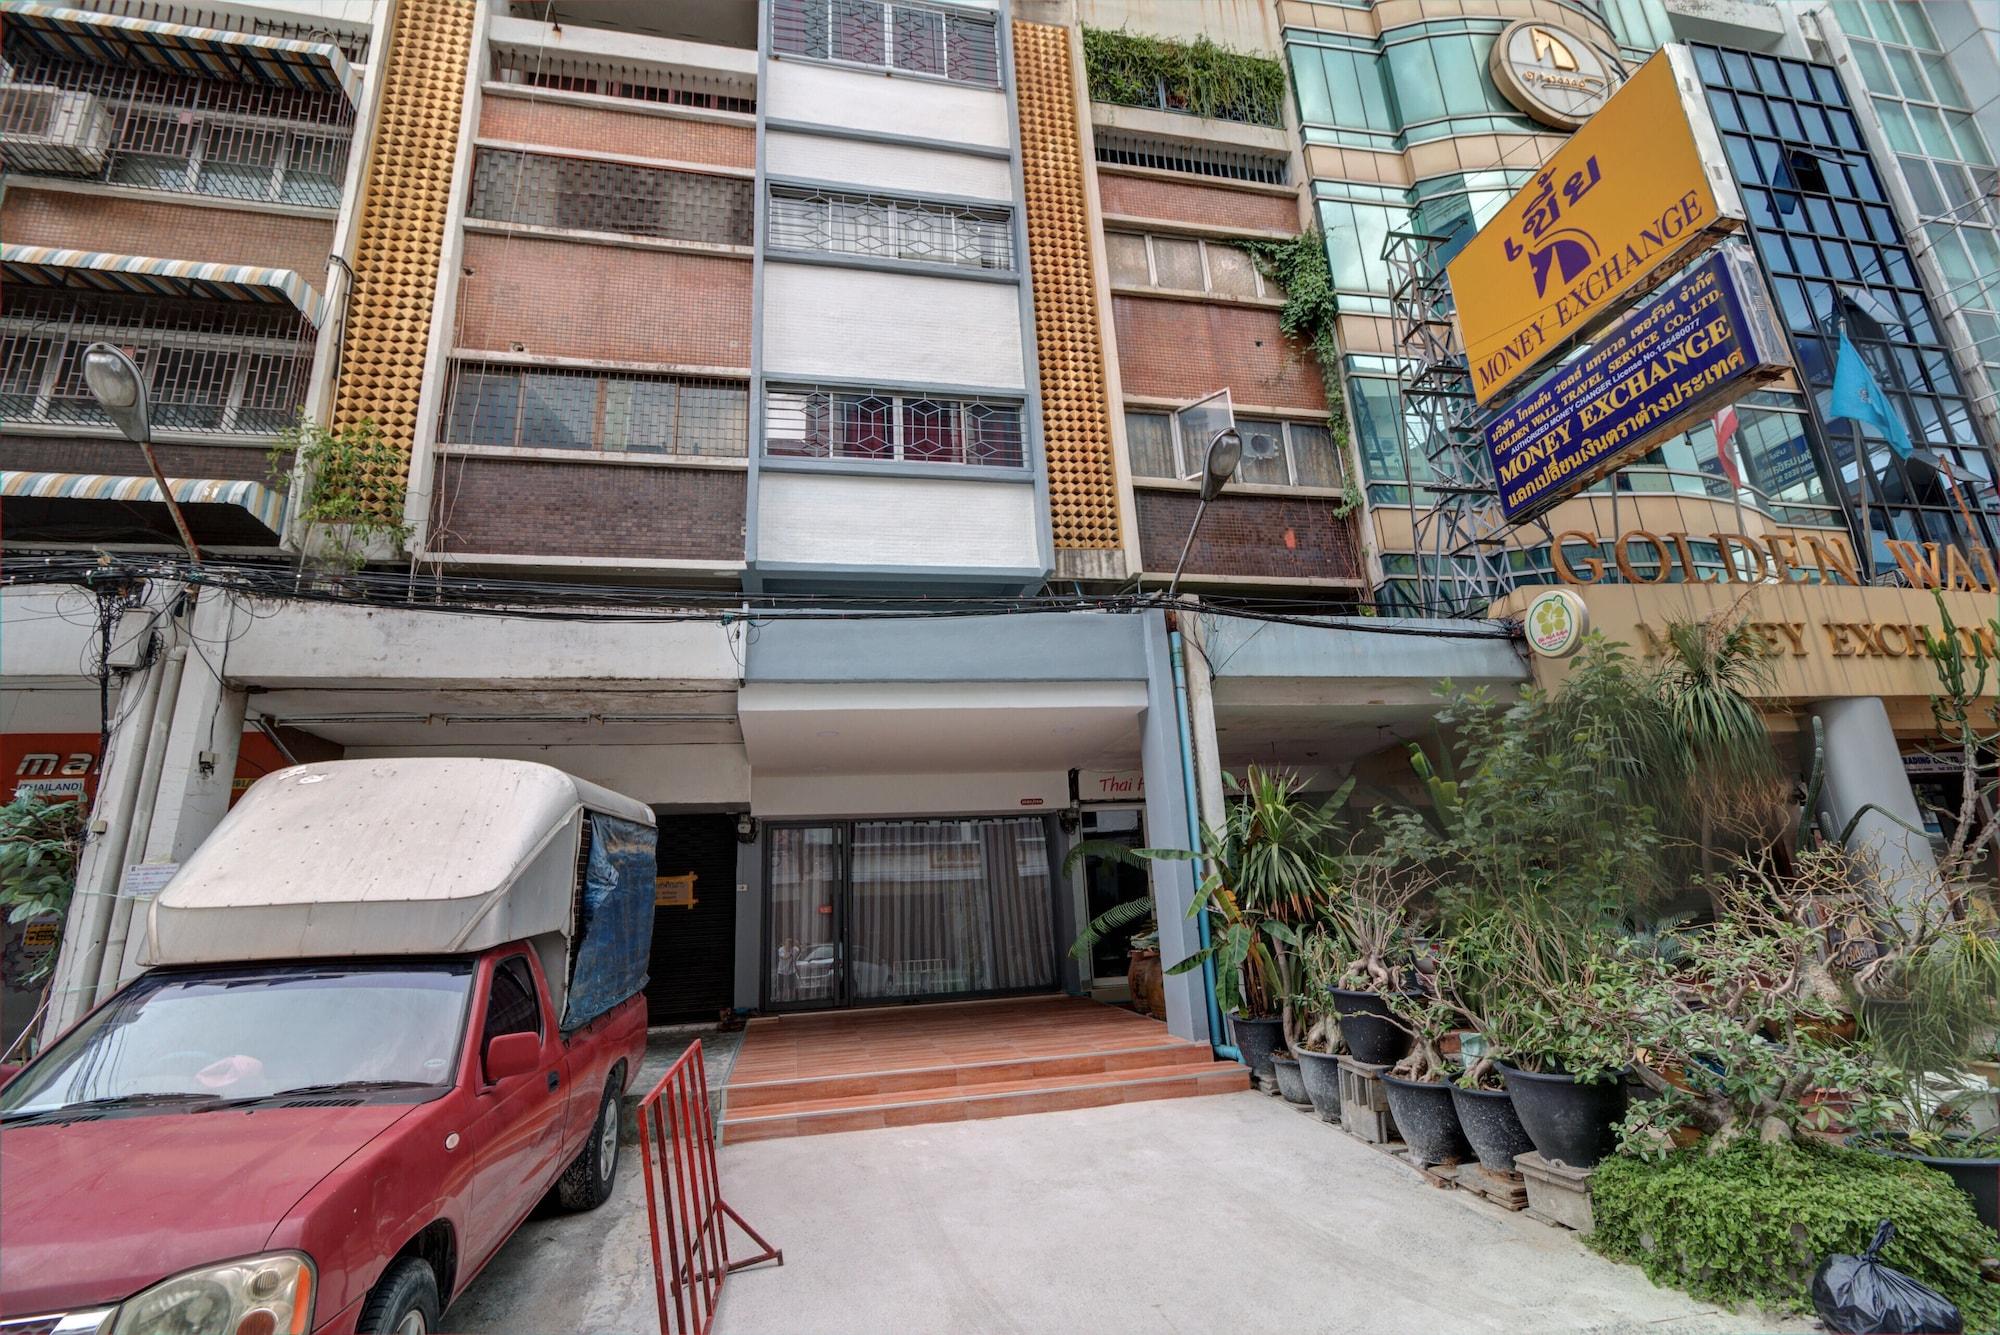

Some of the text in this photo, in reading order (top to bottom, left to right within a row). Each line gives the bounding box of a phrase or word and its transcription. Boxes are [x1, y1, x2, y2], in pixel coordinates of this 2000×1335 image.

[1478, 190, 1703, 391] MONEY EXCHANGE
[1491, 418, 1516, 442] บริษัท
[1679, 272, 1716, 302] จำกัด
[1495, 424, 1530, 455] GOLDEN
[1531, 404, 1559, 427] WALL
[1561, 372, 1604, 406] TRAVEL
[1607, 331, 1660, 374] SERVICE
[1499, 315, 1733, 486] MONEY EXCHANGE
[1508, 347, 1745, 508] แลกเปลี่ยนเงินตราต่างประเทศ
[1511, 423, 1549, 455] AUTHORIZED
[1550, 406, 1574, 427] MONEY
[1575, 378, 1612, 409] CHANGER
[1613, 360, 1642, 383] License
[1551, 529, 1860, 586] GOLDEN
[1099, 776, 1132, 792] Thai
